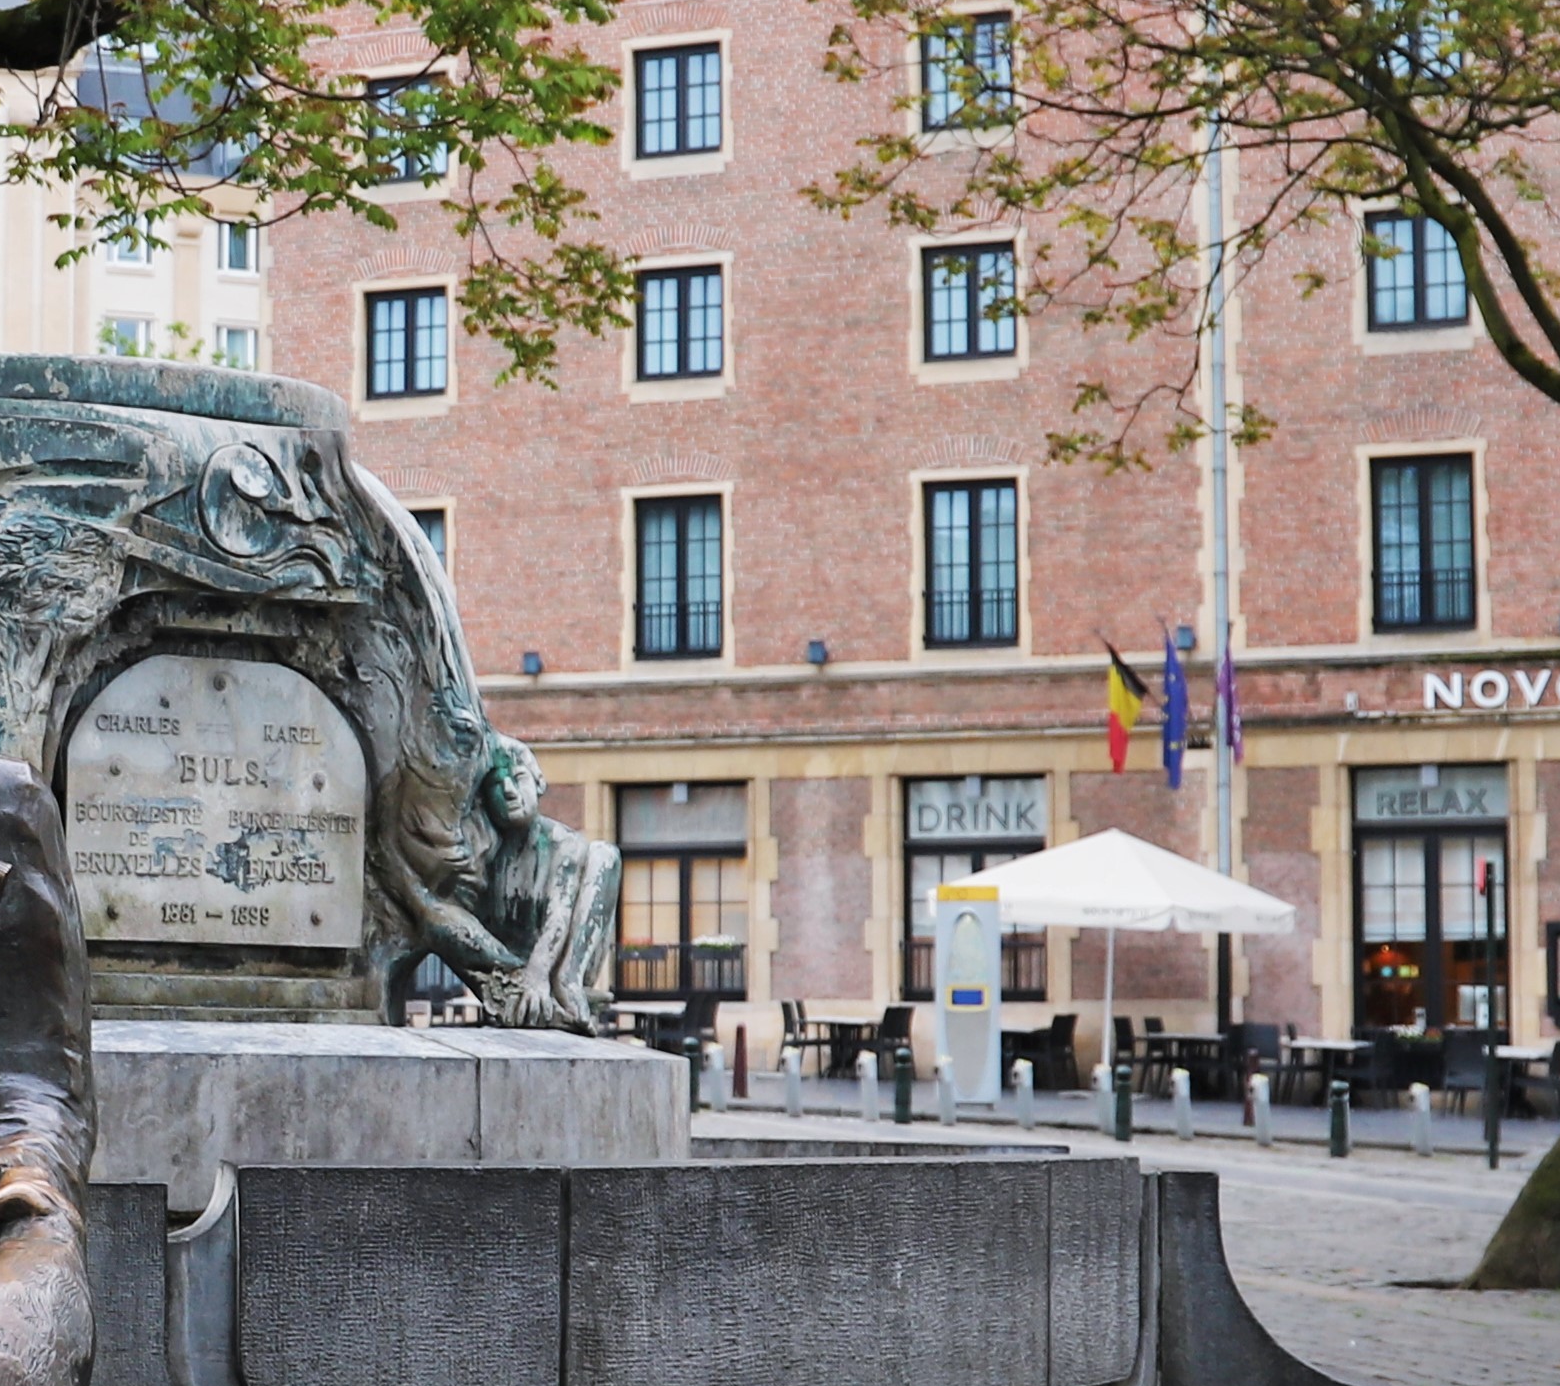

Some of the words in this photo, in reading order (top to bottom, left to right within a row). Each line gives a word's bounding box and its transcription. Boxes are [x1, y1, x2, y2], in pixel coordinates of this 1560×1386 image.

[95, 713, 181, 736] CHARLES
[263, 724, 322, 746] KAREL
[1376, 787, 1489, 816] RELAX
[918, 800, 1037, 832] DRINK
[128, 831, 150, 847] DE
[75, 851, 202, 878] BRUXELLES
[242, 858, 336, 885] BRUSSEL
